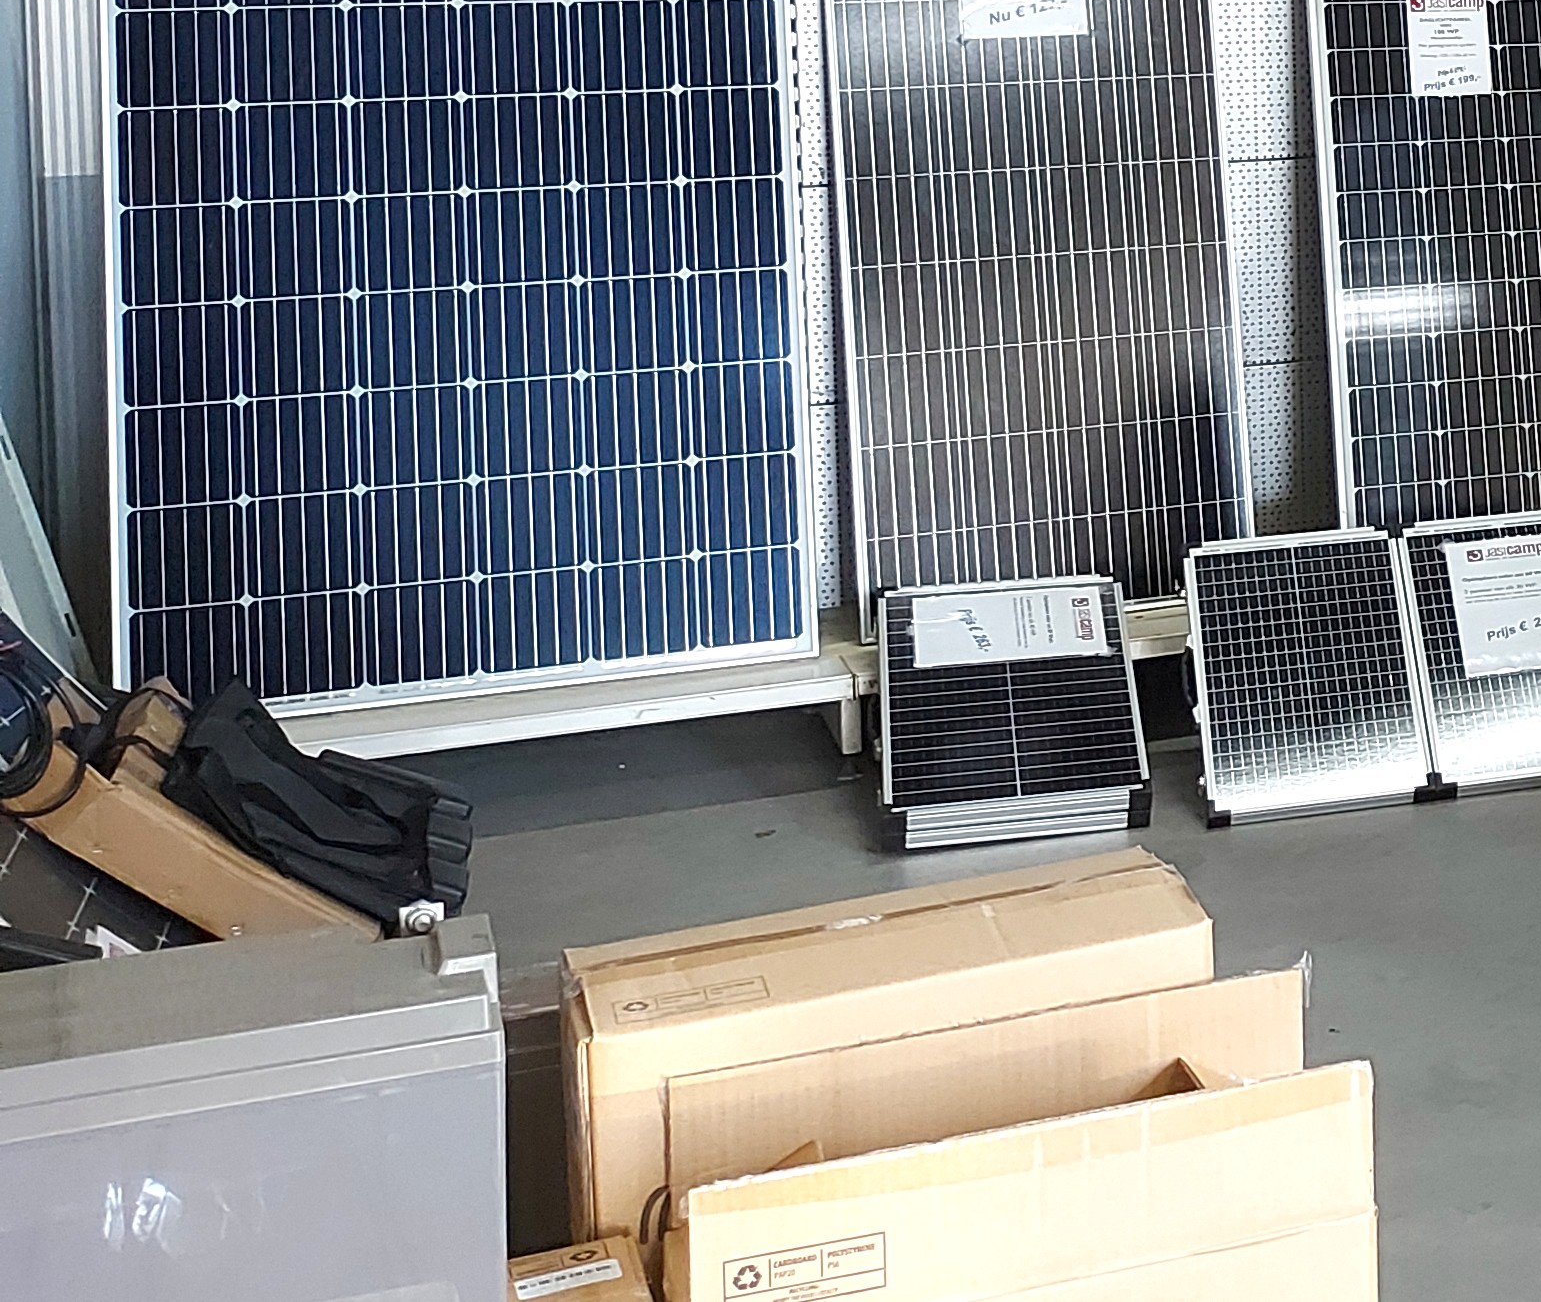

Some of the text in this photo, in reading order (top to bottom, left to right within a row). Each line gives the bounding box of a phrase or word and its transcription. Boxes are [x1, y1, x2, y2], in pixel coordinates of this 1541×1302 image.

[1424, 81, 1446, 91] Prijs
[1487, 626, 1516, 641] Prijs
[1520, 621, 1528, 631] €
